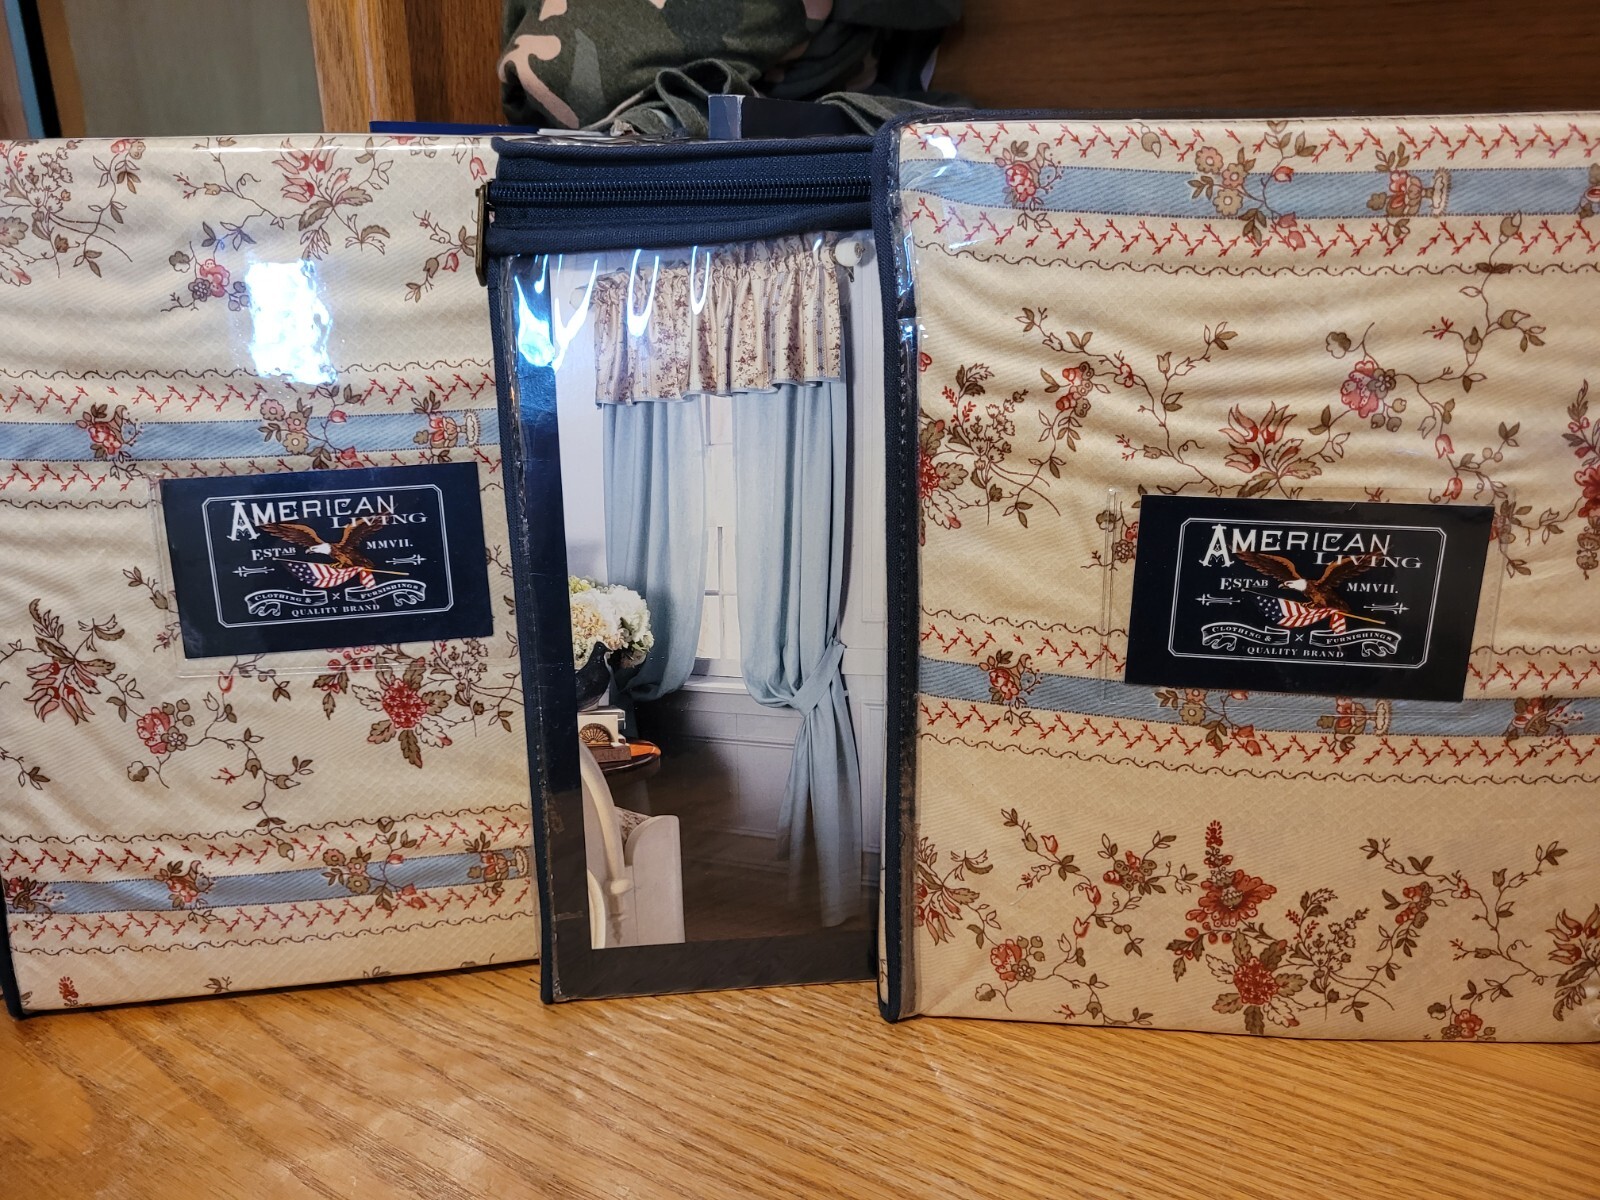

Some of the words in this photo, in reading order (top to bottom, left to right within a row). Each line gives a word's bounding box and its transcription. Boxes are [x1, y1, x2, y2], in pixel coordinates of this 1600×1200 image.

[226, 495, 395, 541] AMERICAN
[331, 512, 428, 529] LIVING
[1199, 524, 1391, 567] AMERICAN
[251, 546, 296, 561] ESTAB
[1313, 552, 1422, 569] LIVING
[1220, 578, 1268, 590] ESTAB
[255, 593, 301, 602] CLOTHING
[360, 583, 419, 600] FURNISHINGS
[291, 606, 338, 617] QUALITY
[343, 604, 380, 613] BRAND
[1212, 626, 1262, 639] CLOTHING
[1326, 632, 1392, 645] FURNISHINGS
[1247, 646, 1298, 656] QUALITY
[1303, 650, 1344, 658] BRAND
